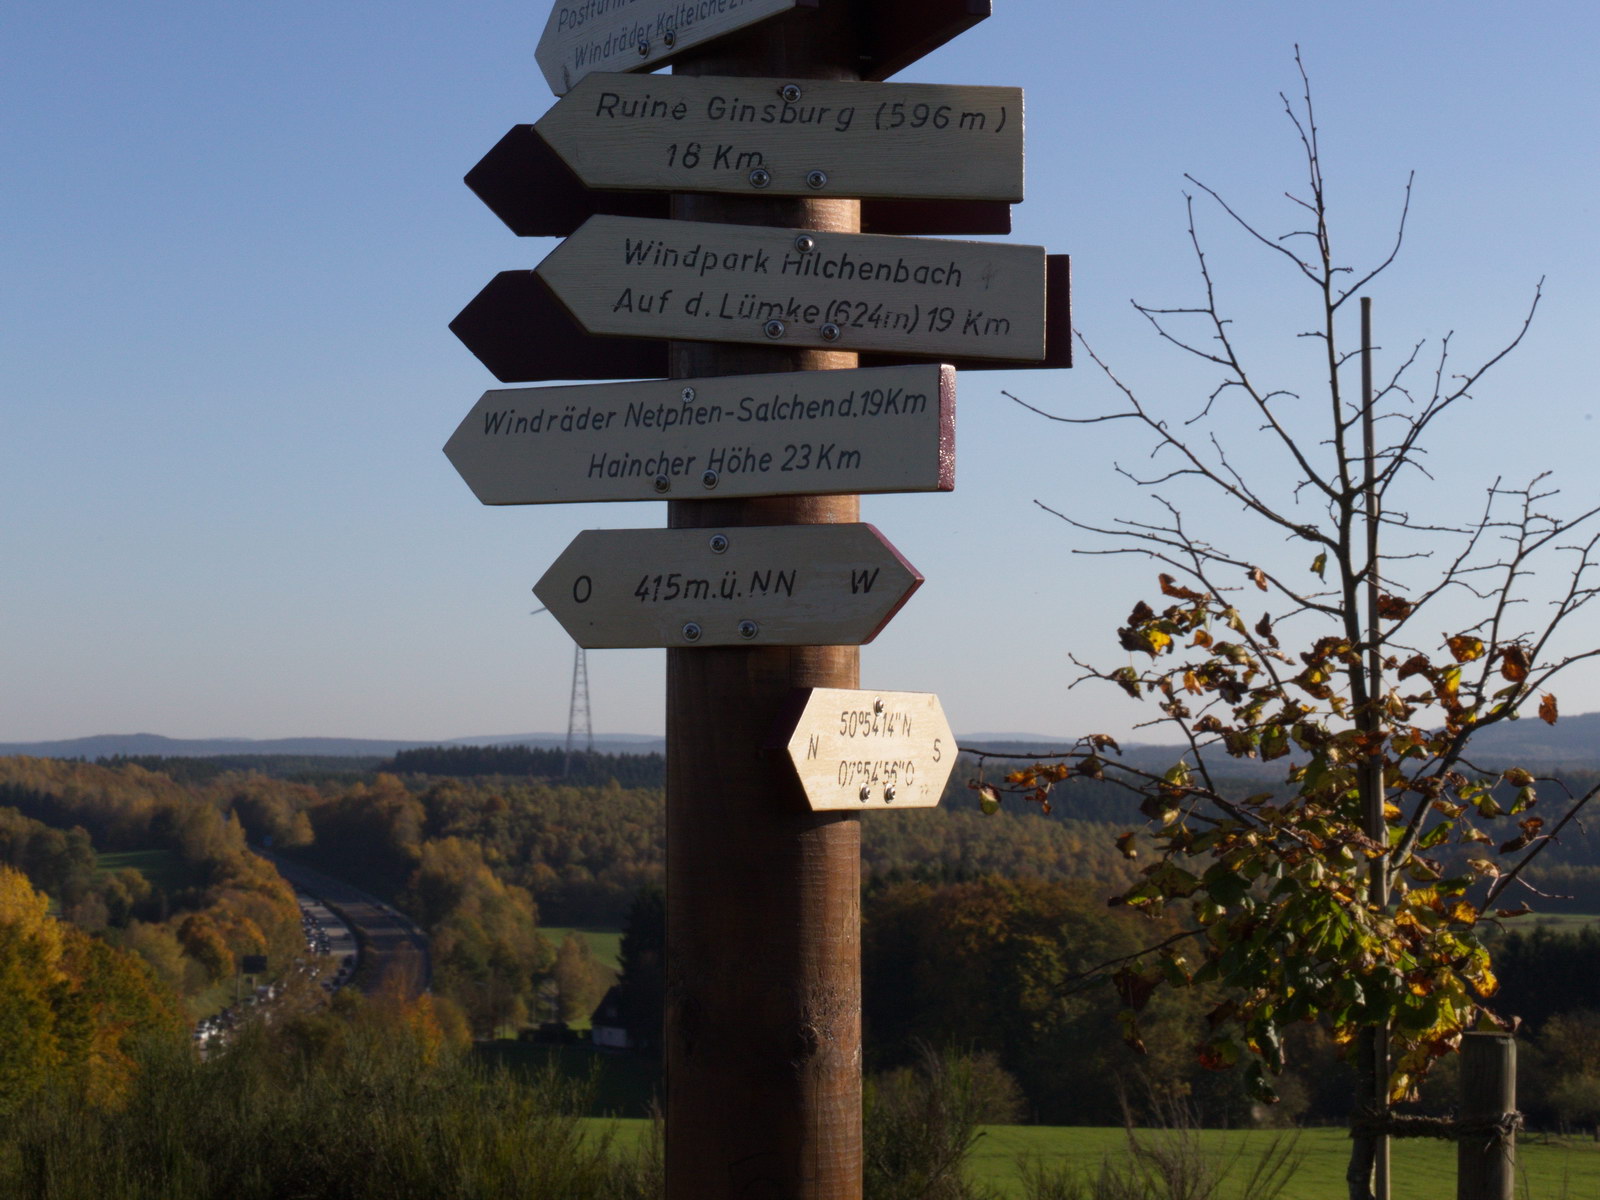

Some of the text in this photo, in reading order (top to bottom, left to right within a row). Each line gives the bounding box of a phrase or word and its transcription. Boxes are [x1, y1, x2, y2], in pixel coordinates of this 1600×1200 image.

[575, 21, 653, 70] Windräder
[596, 92, 688, 121] Ruine
[707, 96, 854, 132] Ginsburg
[624, 238, 961, 288] Windpark Hilchenbach
[614, 287, 672, 313] Auf
[685, 290, 710, 318] d.
[483, 406, 617, 435] Windräder
[588, 451, 696, 480] Haincher
[708, 447, 773, 474] Höhe
[573, 575, 592, 604] O
[850, 568, 880, 595] W
[808, 734, 819, 761] N
[932, 738, 942, 763] S
